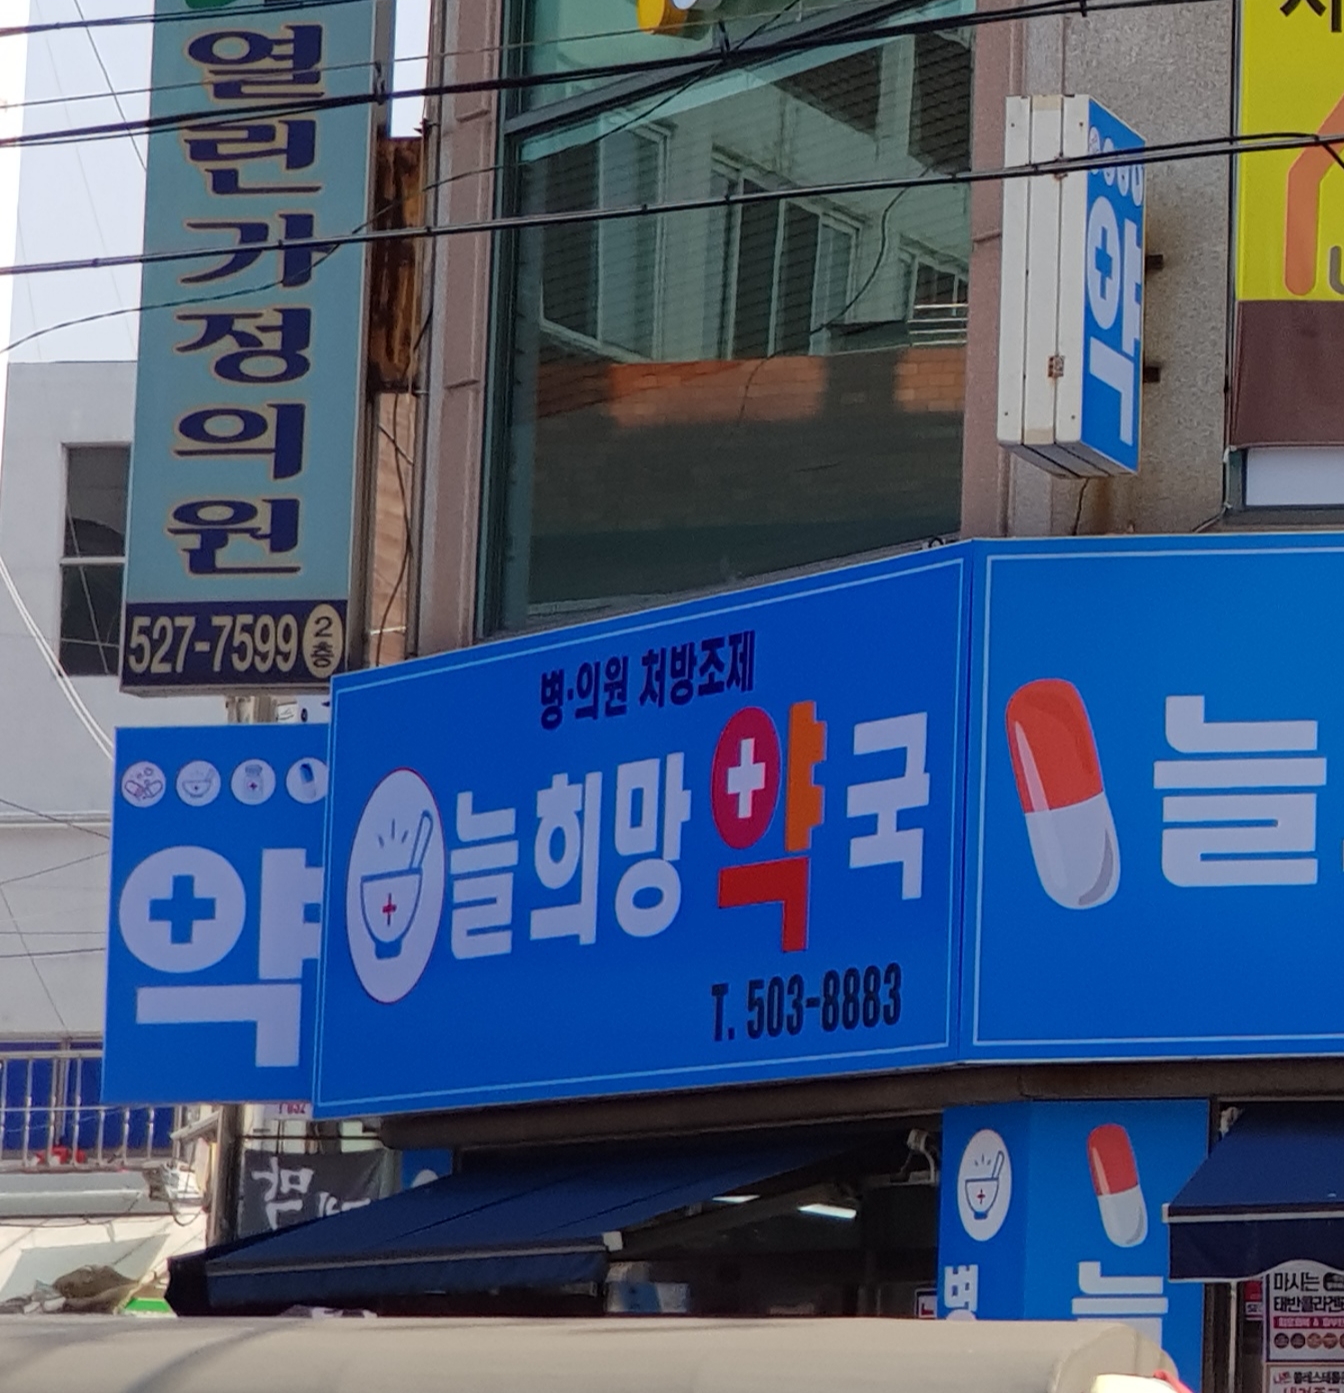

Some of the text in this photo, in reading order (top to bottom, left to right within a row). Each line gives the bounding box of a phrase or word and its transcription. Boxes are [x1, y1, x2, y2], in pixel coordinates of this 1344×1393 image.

[166, 24, 324, 576] 열린가정의원
[127, 611, 299, 676] 527-7599
[640, 629, 757, 709] 처방조제
[450, 699, 930, 961] 늘희망약국
[711, 960, 903, 1041] T. 503-8883
